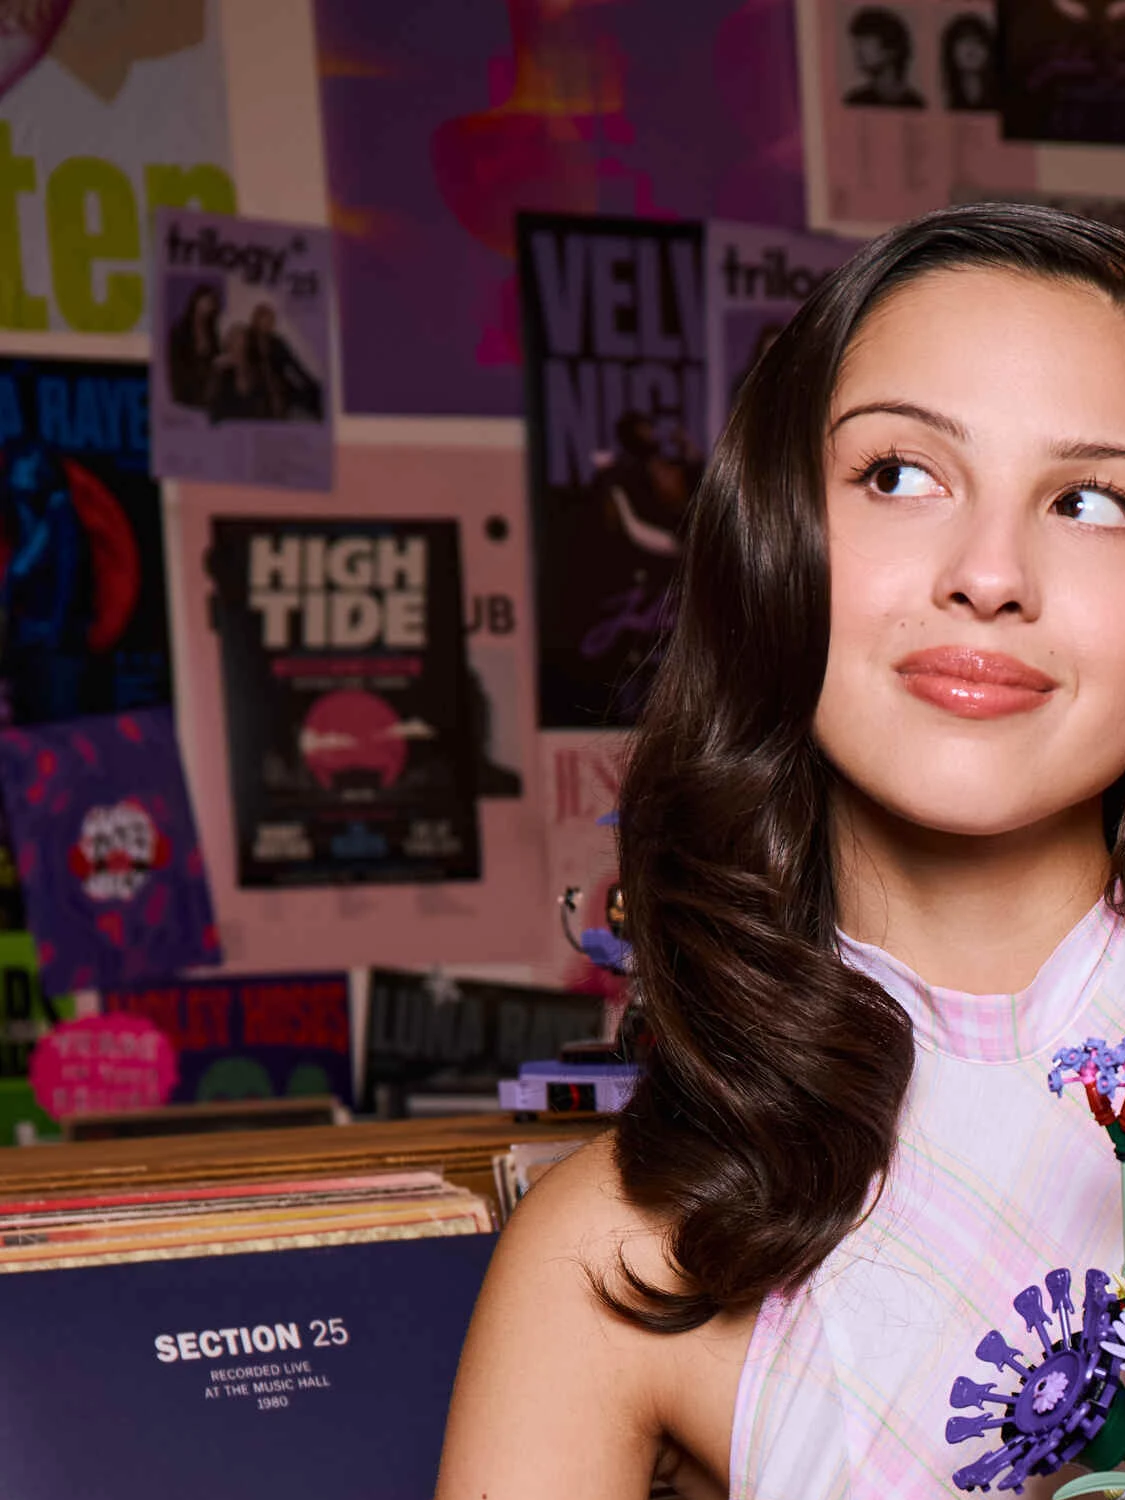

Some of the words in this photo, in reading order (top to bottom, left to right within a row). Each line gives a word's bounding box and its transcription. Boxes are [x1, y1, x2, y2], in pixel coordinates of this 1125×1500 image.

[166, 221, 286, 286] trilogy
[248, 534, 431, 589] HIGH
[249, 592, 429, 650] TIDE
[154, 1323, 302, 1363] SECTION
[309, 1318, 349, 1347] 25
[204, 1387, 220, 1400] AT
[224, 1383, 250, 1397] THE
[253, 1379, 294, 1394] MUSIC
[298, 1375, 331, 1389] HALL
[210, 1364, 280, 1382] RECORDED
[283, 1361, 312, 1375] LIVE
[257, 1395, 289, 1411] 1980
